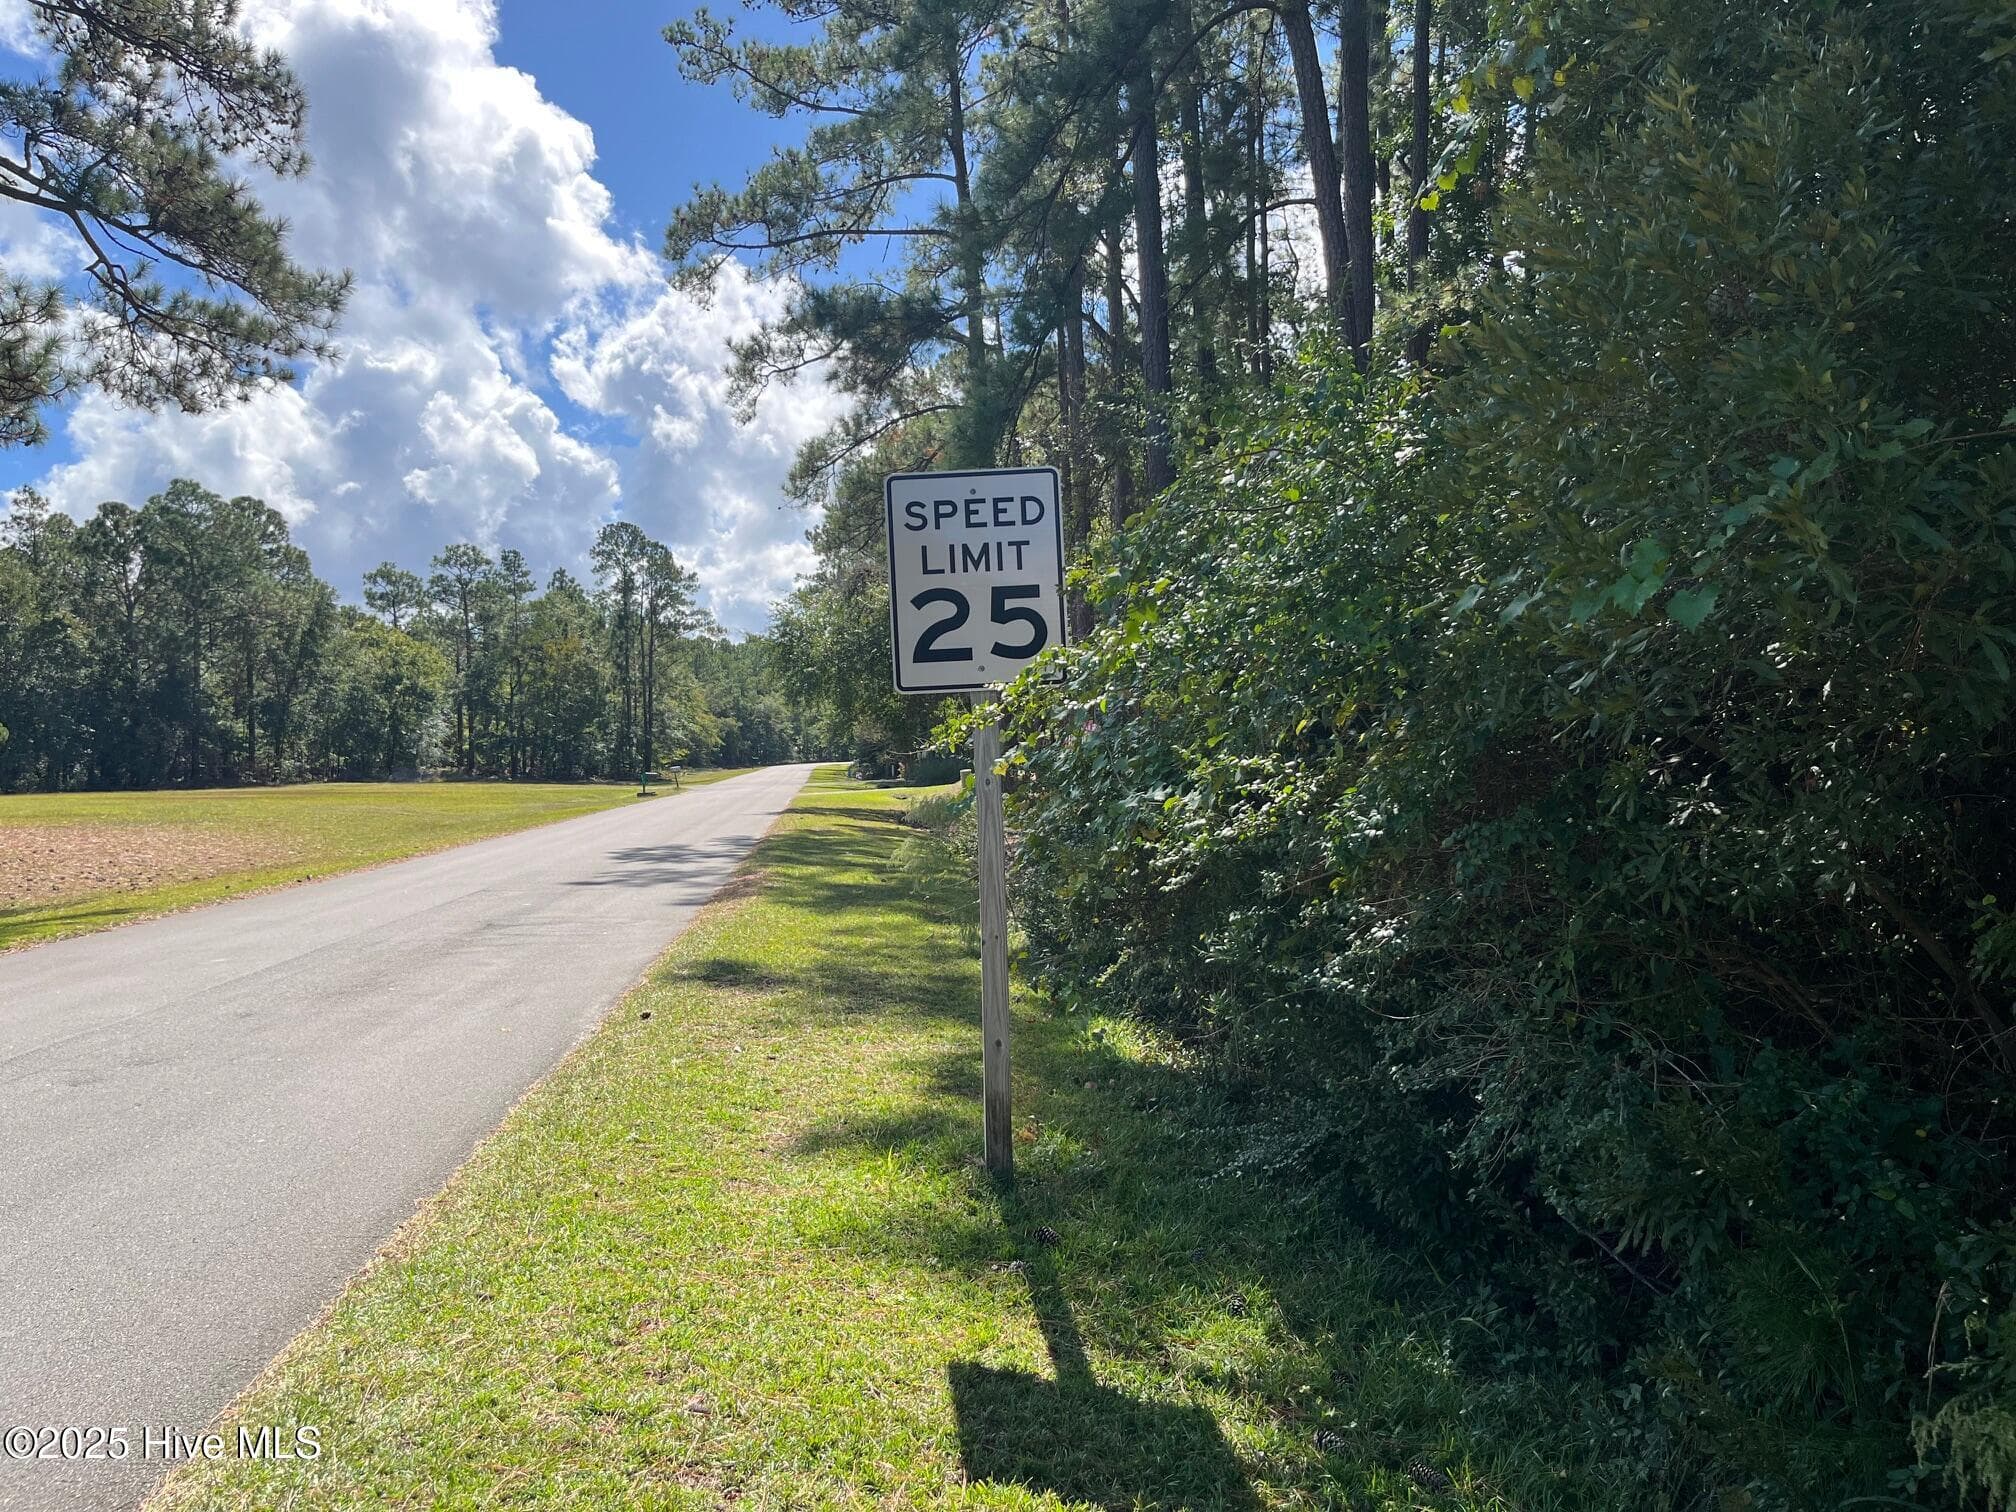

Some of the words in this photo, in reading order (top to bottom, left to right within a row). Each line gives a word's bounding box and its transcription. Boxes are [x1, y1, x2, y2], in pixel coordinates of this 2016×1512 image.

[904, 496, 1045, 531] SPEED
[921, 540, 1030, 575] LIMIT
[910, 584, 1048, 663] 25
